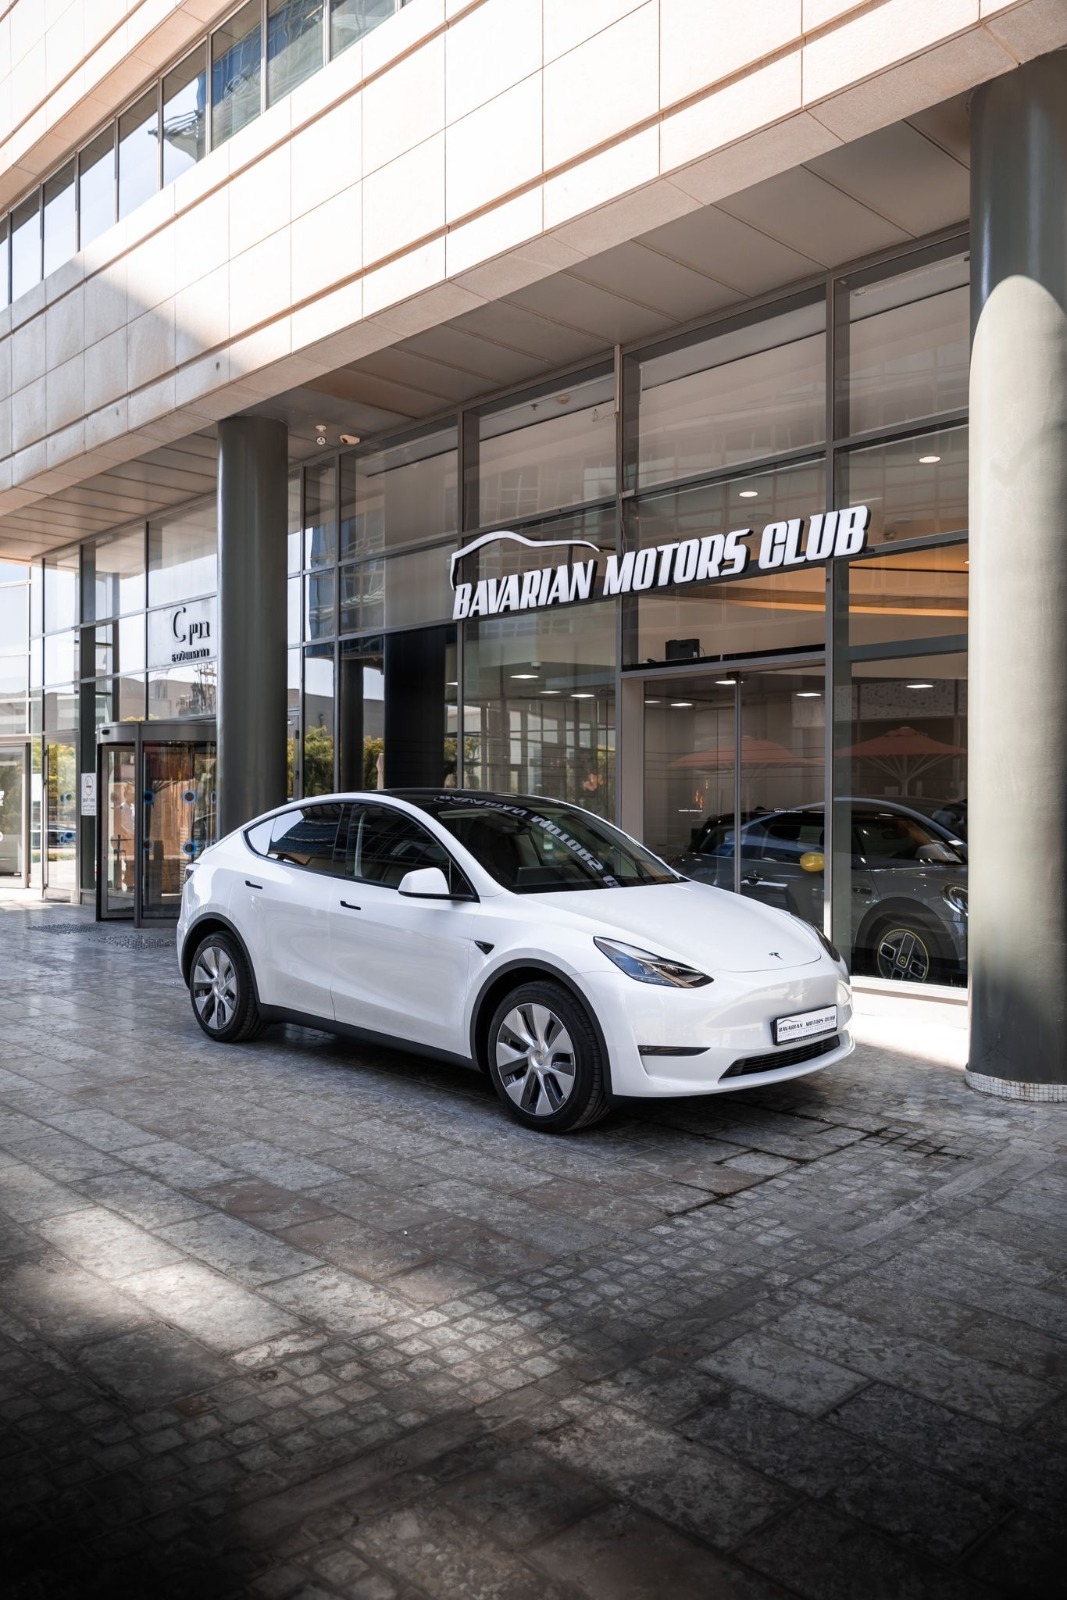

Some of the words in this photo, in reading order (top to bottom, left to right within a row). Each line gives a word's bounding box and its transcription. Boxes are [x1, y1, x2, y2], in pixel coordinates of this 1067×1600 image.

[452, 559, 598, 620] BAVARIAN
[602, 528, 752, 596] MOTORS
[758, 505, 869, 570] CLUB
[173, 606, 187, 643] C
